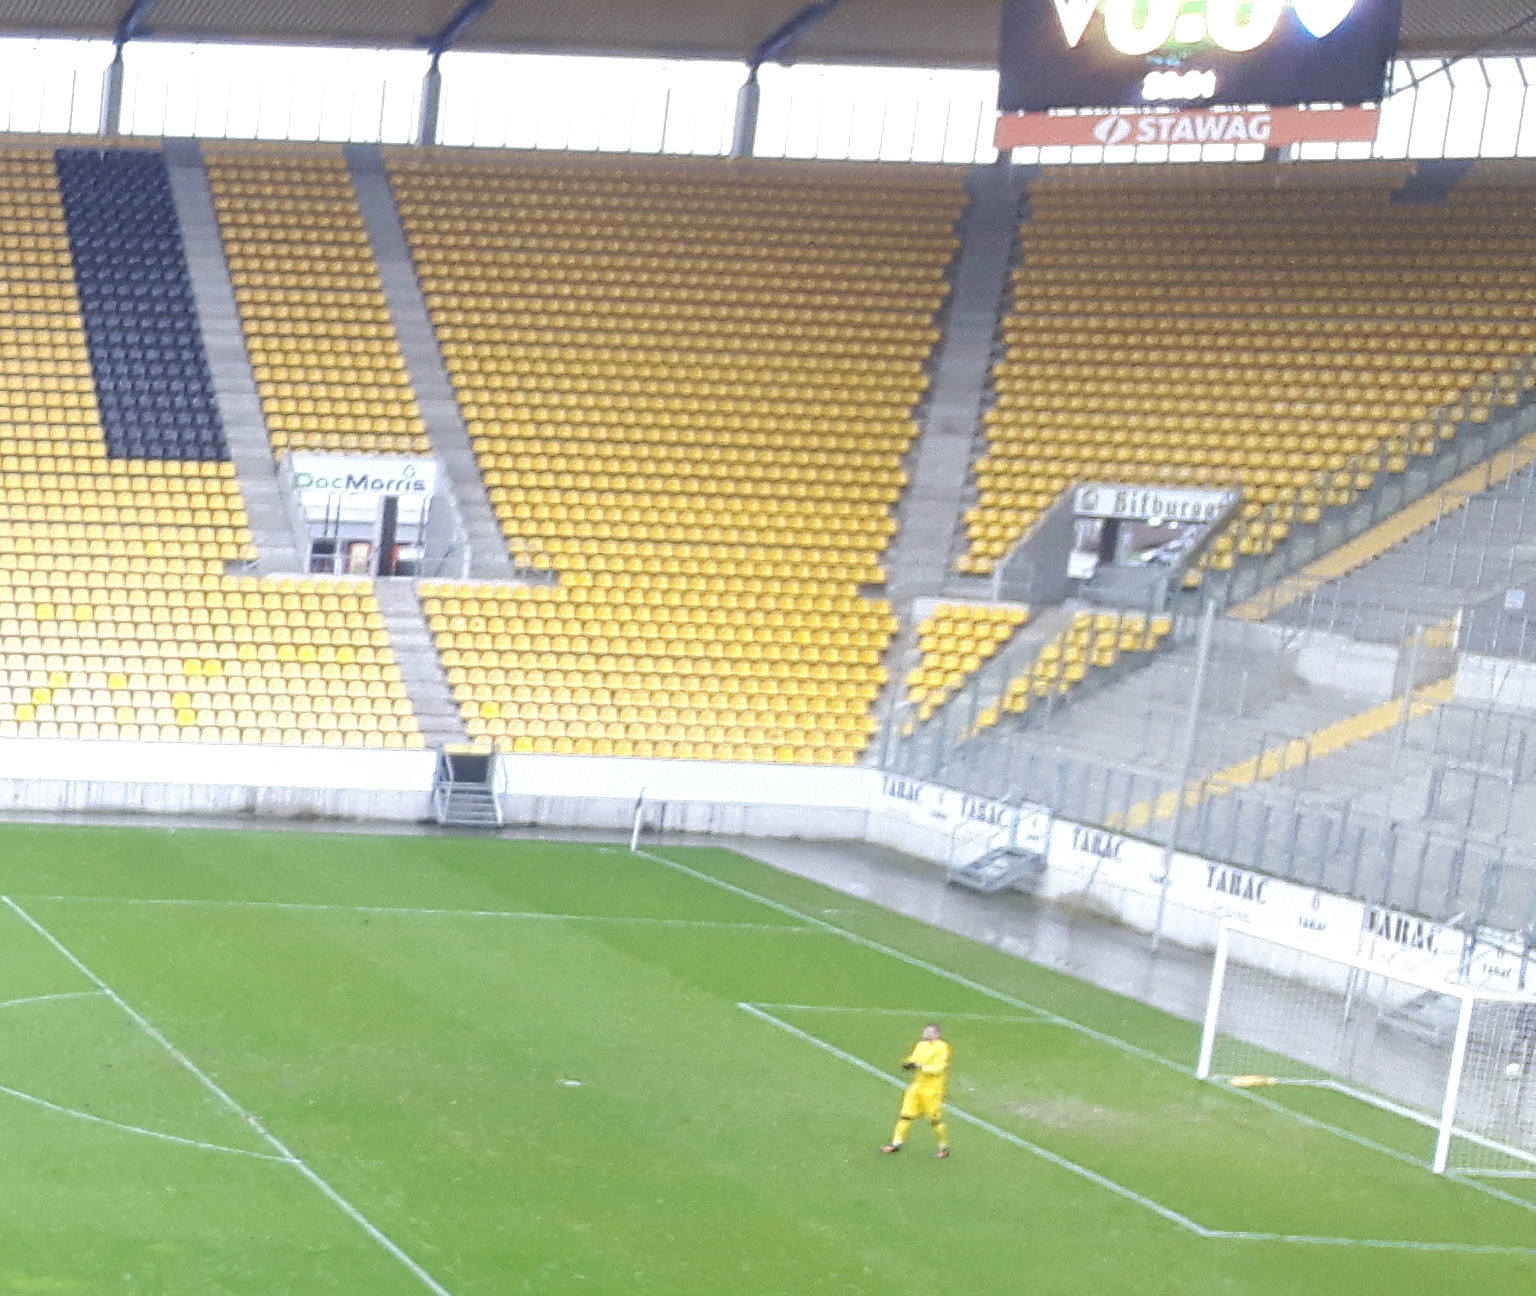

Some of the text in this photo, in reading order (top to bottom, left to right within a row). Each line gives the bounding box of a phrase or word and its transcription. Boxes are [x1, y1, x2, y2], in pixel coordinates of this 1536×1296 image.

[1136, 115, 1272, 143] STAWAG
[294, 465, 426, 491] DocMorris
[1207, 862, 1268, 904] TABAC
